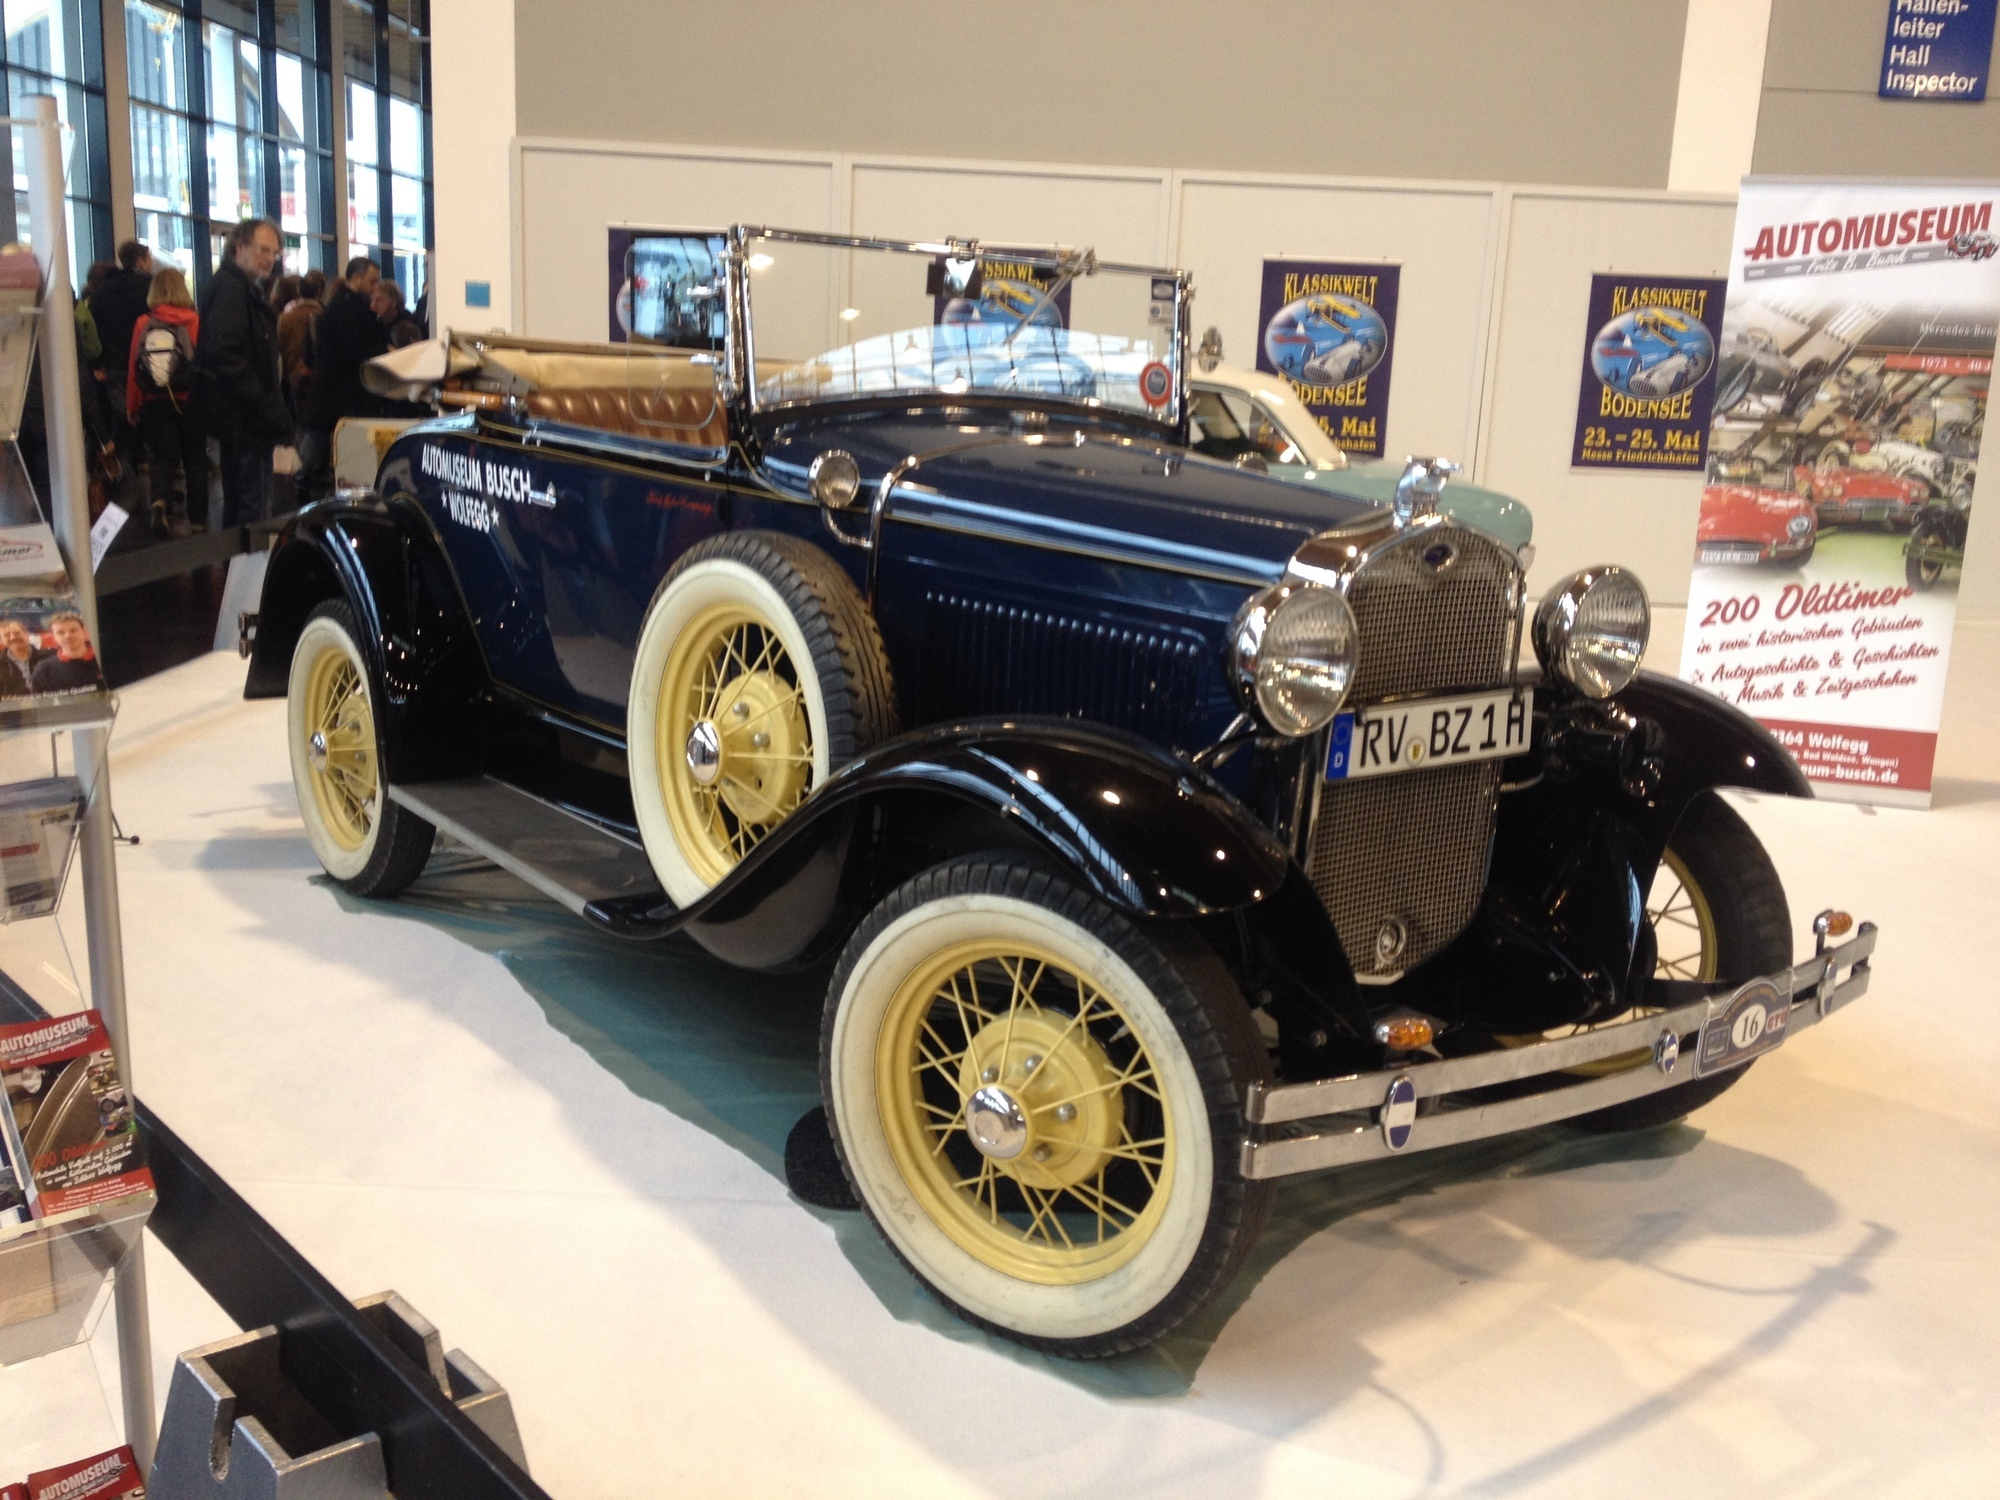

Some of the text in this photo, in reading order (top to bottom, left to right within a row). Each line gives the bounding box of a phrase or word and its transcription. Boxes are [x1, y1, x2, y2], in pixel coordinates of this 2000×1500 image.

[1893, 15, 1945, 38] leiter
[1890, 44, 1931, 67] Hall
[1886, 69, 1977, 97] Inspector
[1744, 201, 1993, 261] AUTOMUSEUM
[1284, 273, 1378, 306] KLASSIKWELT
[1612, 286, 1708, 320] KLASSIKWELT
[1600, 384, 1693, 420] BODENSEE
[1341, 416, 1377, 438] Mai
[1583, 426, 1612, 447] 23.
[1630, 428, 1658, 448] 25.
[1664, 430, 1700, 450] Mai
[1616, 449, 1699, 465] Friedrichshafen
[421, 443, 532, 505] AUTOMUSEUM BUSCH
[449, 490, 490, 534] WOLFEGG
[1700, 581, 1914, 628] 200 Oldtimer
[1696, 614, 1923, 655] in zwei historischen Gebäuden
[1711, 644, 1940, 687] Autogeschichte & Geschichten
[1736, 672, 1918, 705] Musik & Zeitgeschehen
[1333, 752, 1344, 768] D
[1360, 714, 1408, 768] RV
[1808, 732, 1869, 755] Wolfegg
[1800, 764, 1899, 784] eum-busch.de
[0, 1014, 89, 1053] AUTOMUSEUM
[1740, 1010, 1760, 1043] 16
[38, 1453, 121, 1500] AUTOMUSEUM
